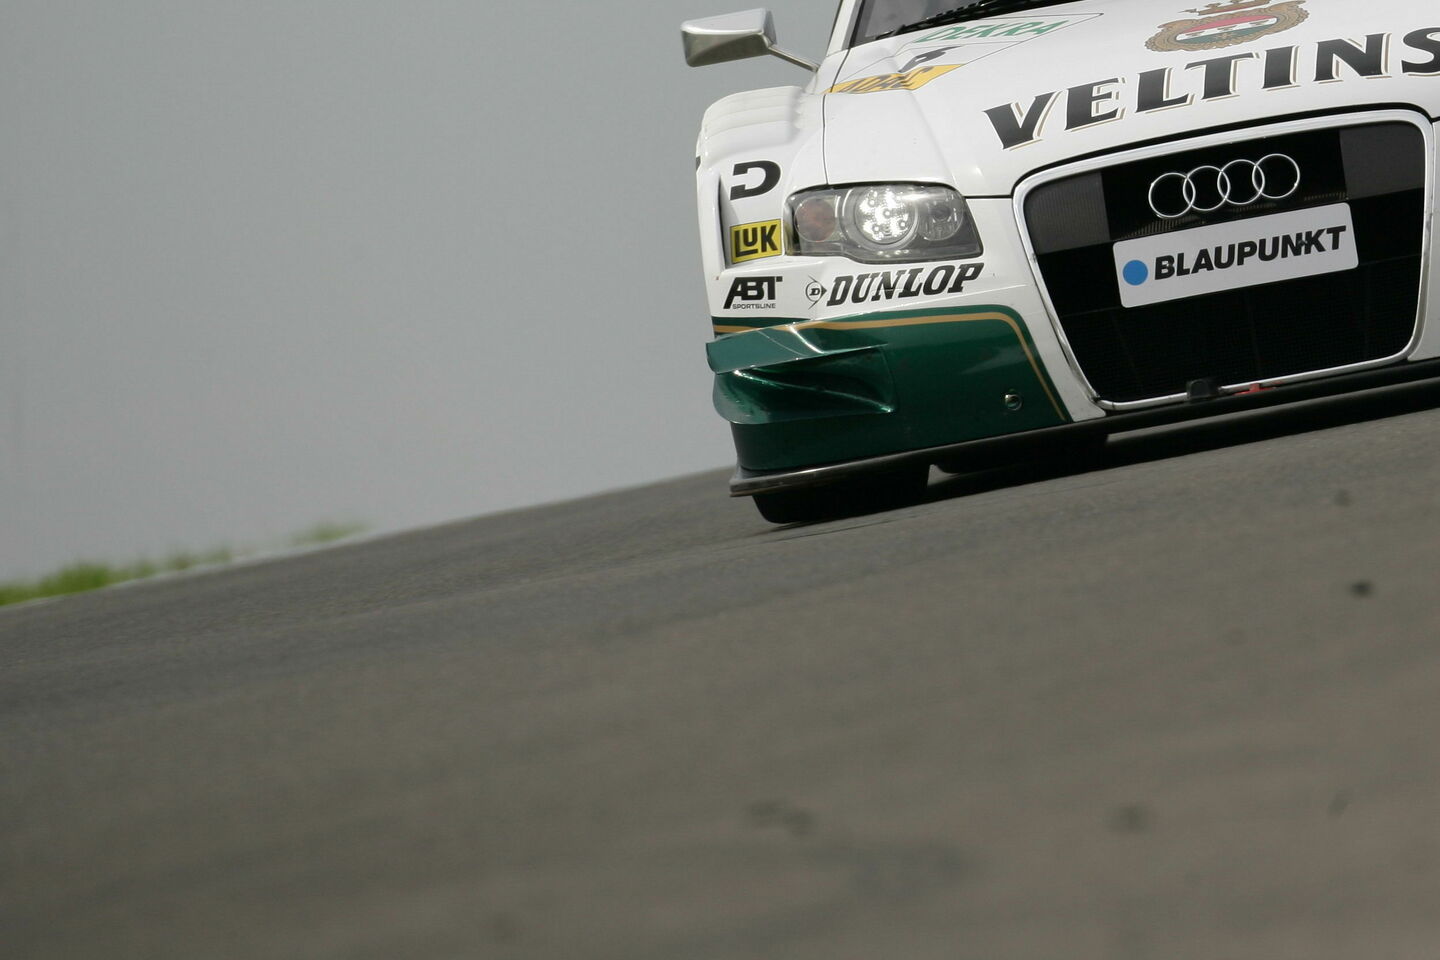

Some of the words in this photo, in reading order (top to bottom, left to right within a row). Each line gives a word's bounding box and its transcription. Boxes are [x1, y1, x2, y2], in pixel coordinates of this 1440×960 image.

[914, 20, 1069, 43] DEKRA
[1154, 225, 1347, 280] BLAUPUNKT
[723, 276, 783, 309] ABT
[826, 263, 985, 306] DUNLOP
